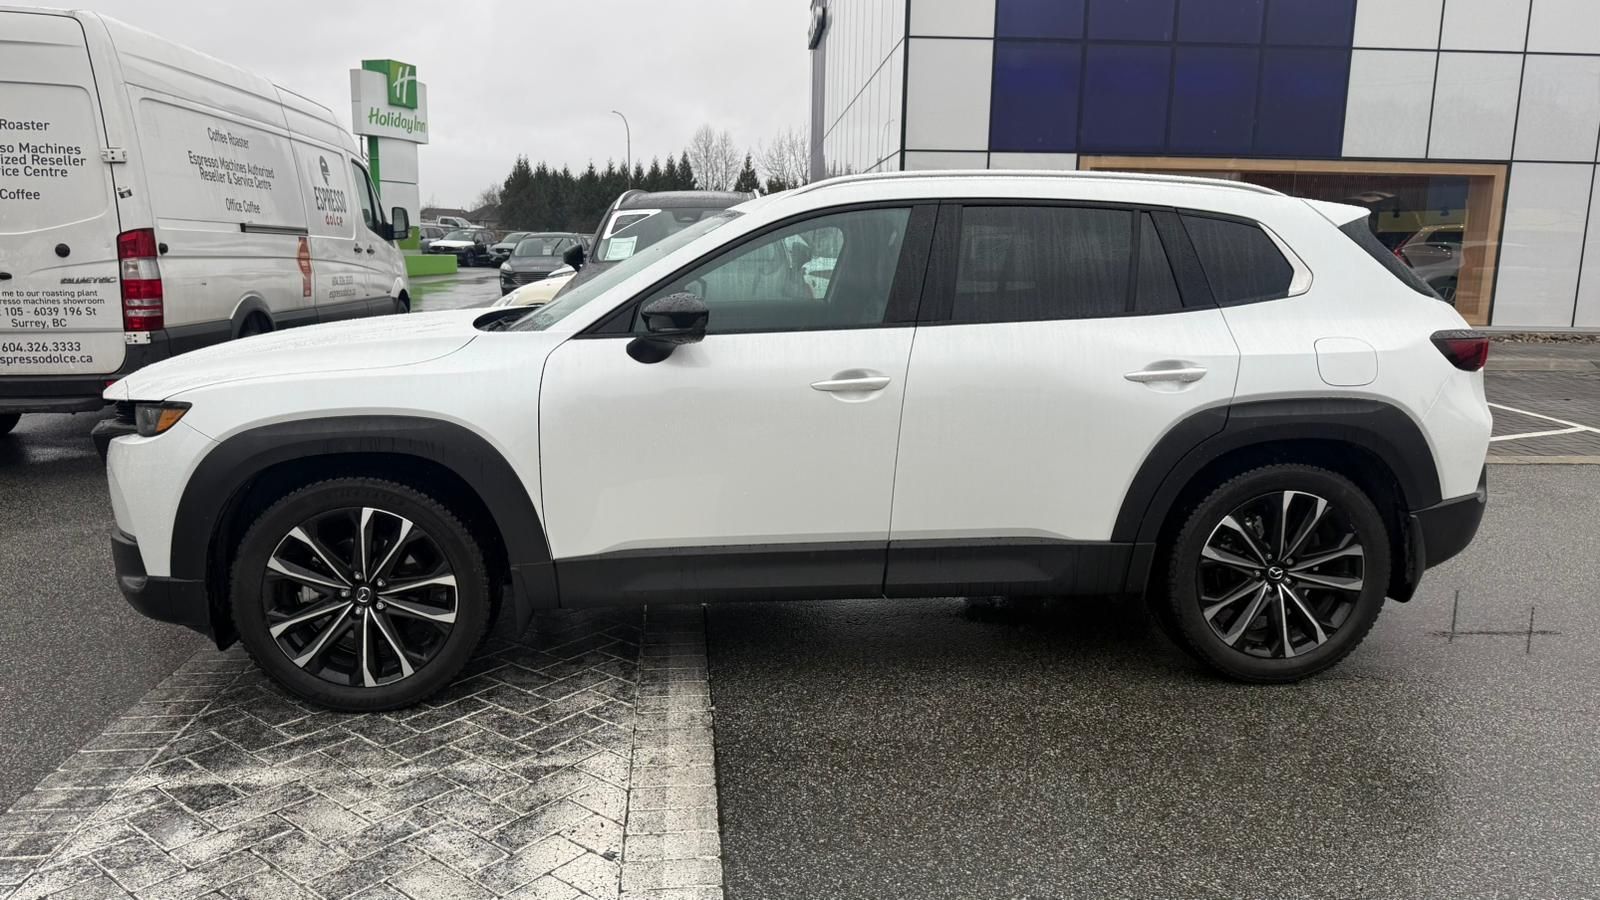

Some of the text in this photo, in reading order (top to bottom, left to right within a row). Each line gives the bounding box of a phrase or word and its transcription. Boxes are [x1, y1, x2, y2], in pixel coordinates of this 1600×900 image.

[0, 118, 50, 131] Roaster
[368, 106, 426, 134] Holiday Inn
[207, 127, 249, 149] Coffee Roaster
[18, 142, 82, 155] Machines
[0, 154, 87, 166] ized Reseller
[188, 150, 275, 179] Espresso Machines Authorized
[23, 165, 68, 177] Centre
[200, 166, 272, 190] Reseller & Service Centre
[0, 188, 41, 200] Coffee
[314, 186, 347, 213] ESPRESSO
[225, 197, 261, 214] Office Coffee
[325, 211, 343, 227] dolce
[42, 289, 75, 298] roasting
[77, 289, 98, 298] plant
[23, 297, 61, 305] machines
[63, 297, 105, 305] showroom
[4, 306, 24, 317] 105
[33, 306, 60, 317] 6039
[63, 306, 82, 316] 196
[85, 306, 97, 316] St
[11, 317, 68, 330] Surrey, BC
[2, 341, 81, 353] 604.326.3333
[0, 353, 93, 366] spressodolce.ca
